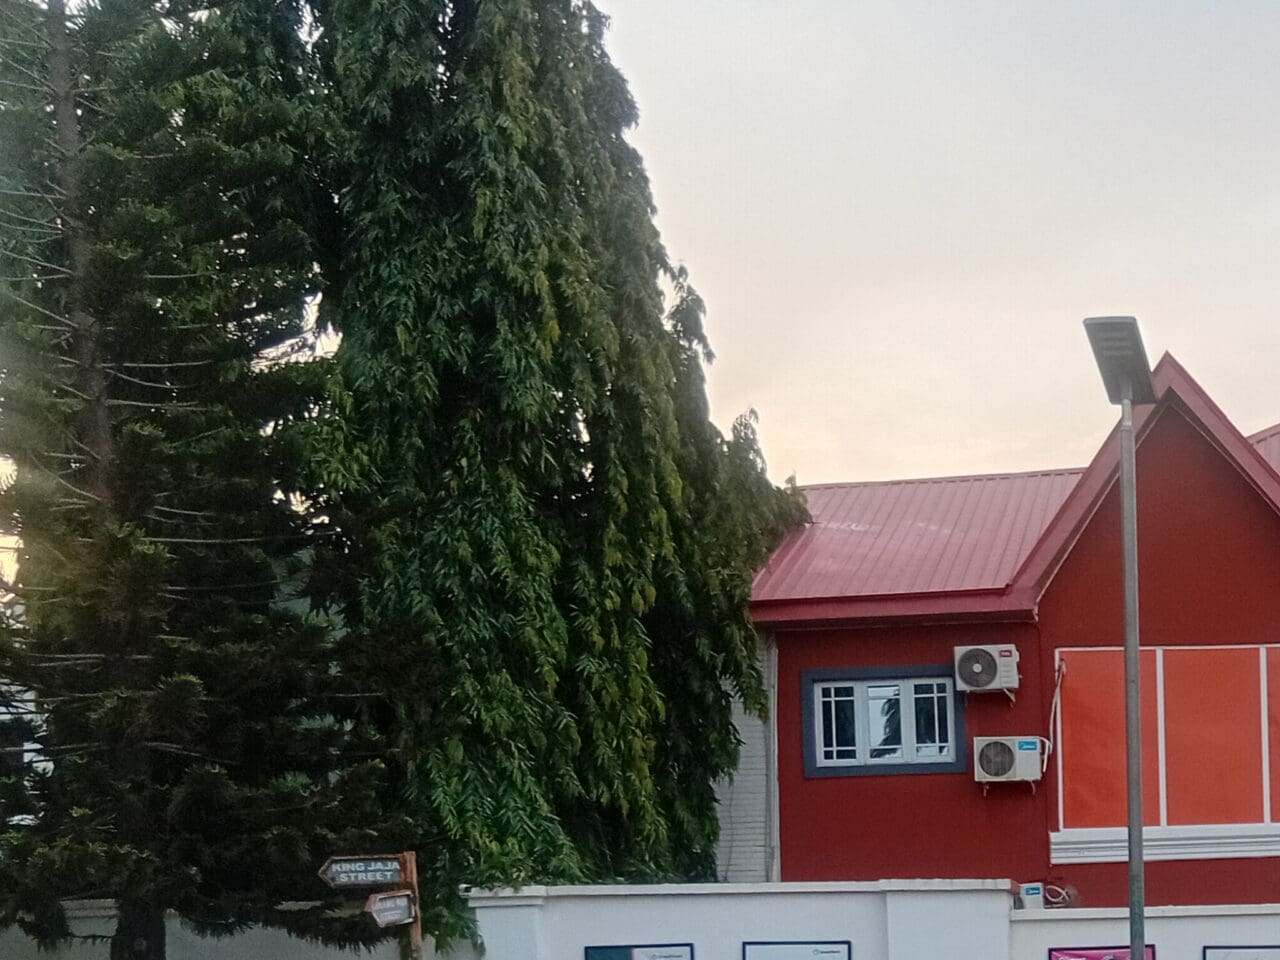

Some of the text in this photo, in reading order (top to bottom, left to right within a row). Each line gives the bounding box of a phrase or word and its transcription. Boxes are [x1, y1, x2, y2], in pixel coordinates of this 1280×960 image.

[331, 861, 400, 872] KING JAJA
[340, 871, 393, 881] STREET
